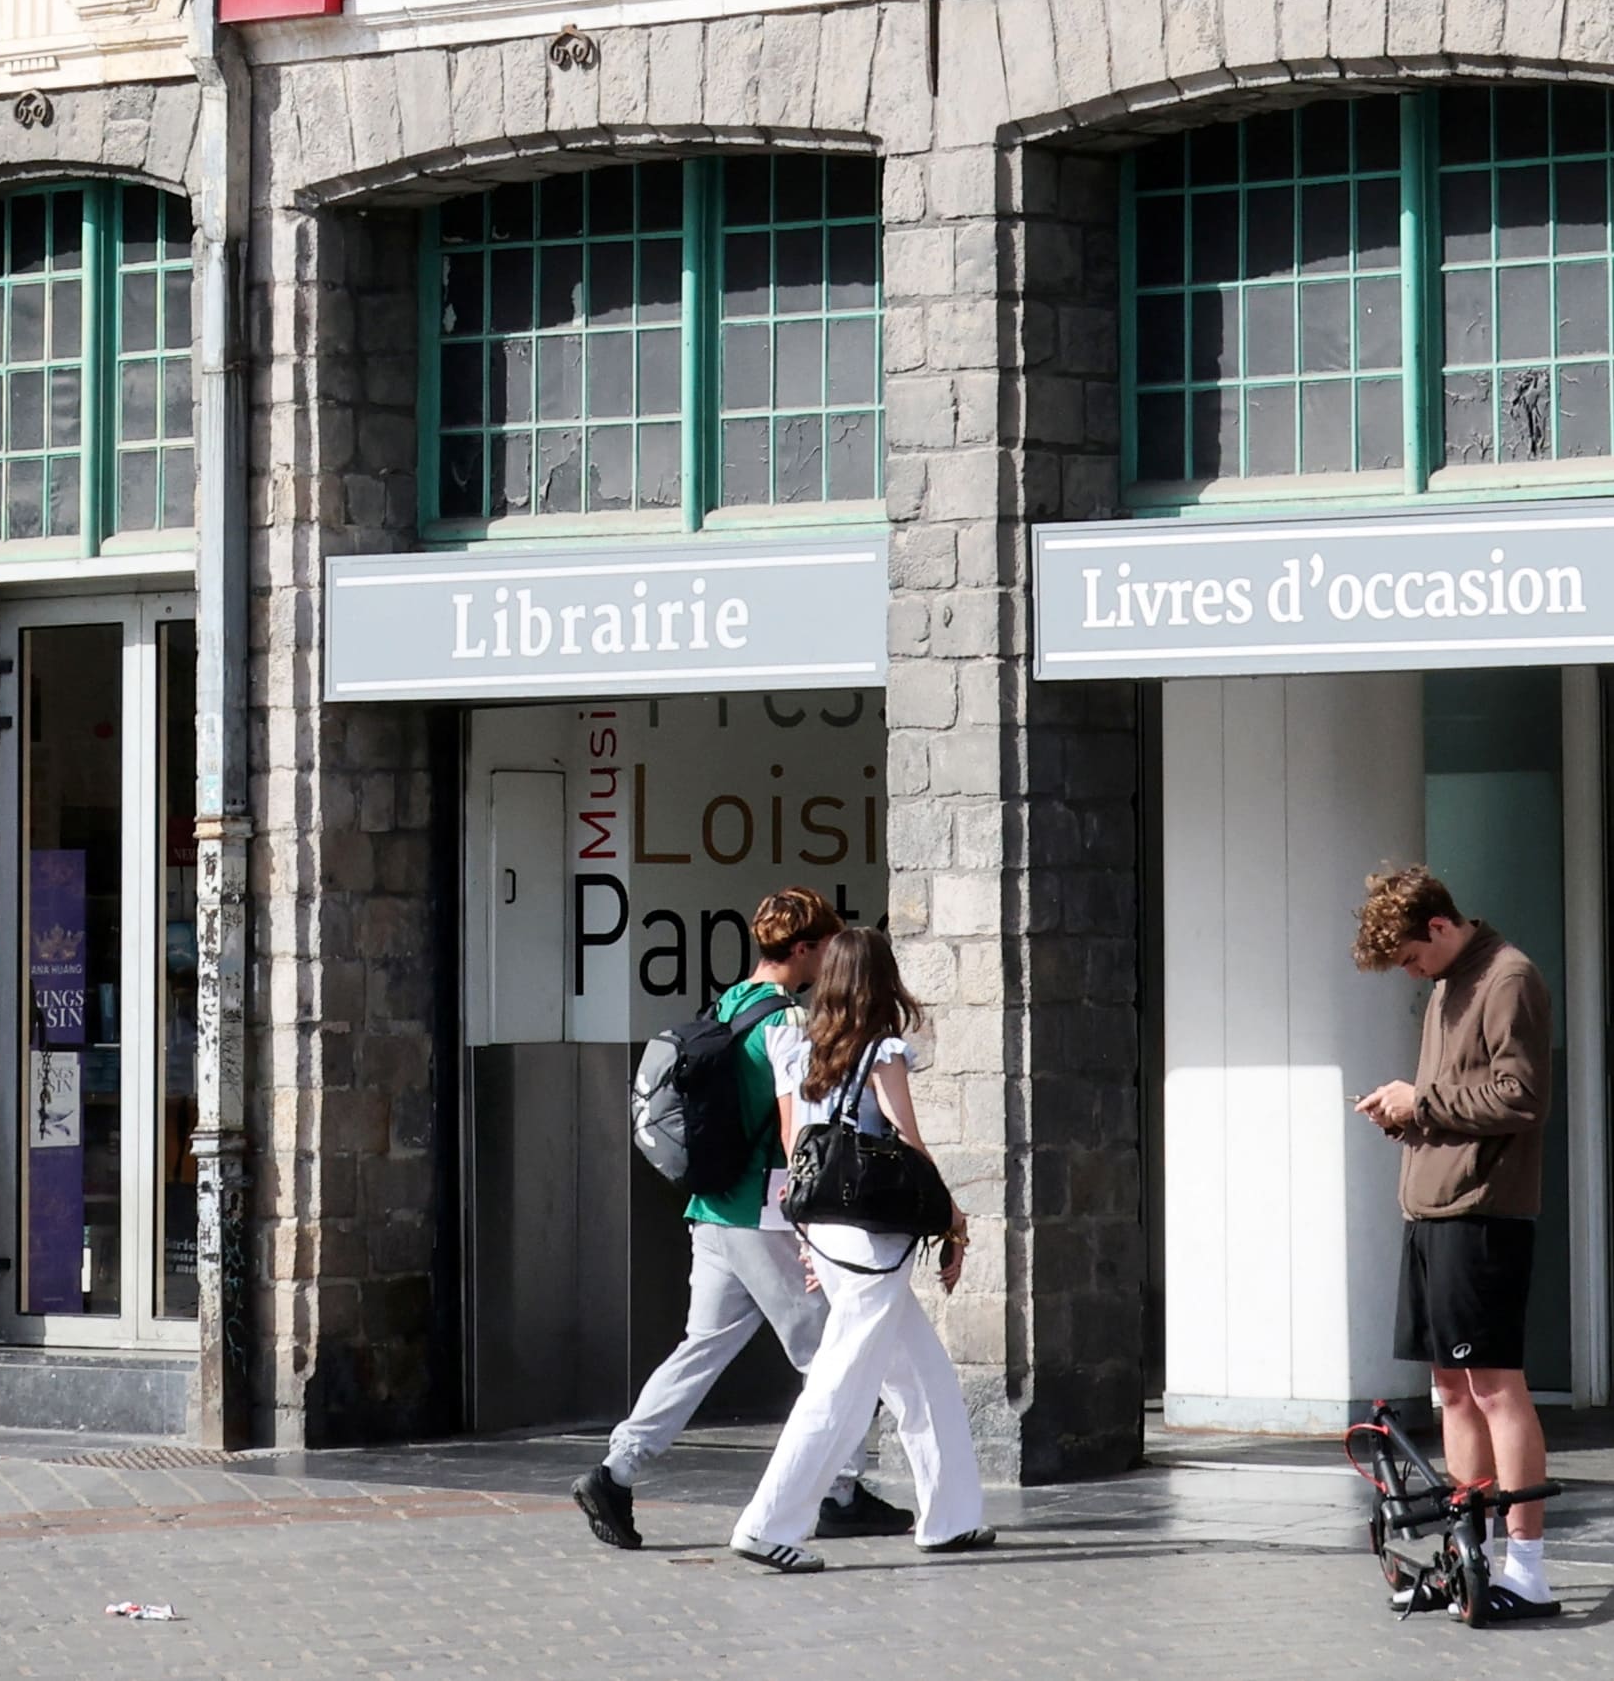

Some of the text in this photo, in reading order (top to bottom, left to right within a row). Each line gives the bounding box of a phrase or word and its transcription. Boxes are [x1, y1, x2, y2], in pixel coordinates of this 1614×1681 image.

[450, 578, 750, 660] Librairie
[1082, 548, 1587, 629] Livres d'occasion
[578, 710, 617, 860] Musi
[634, 763, 877, 865] Loisi
